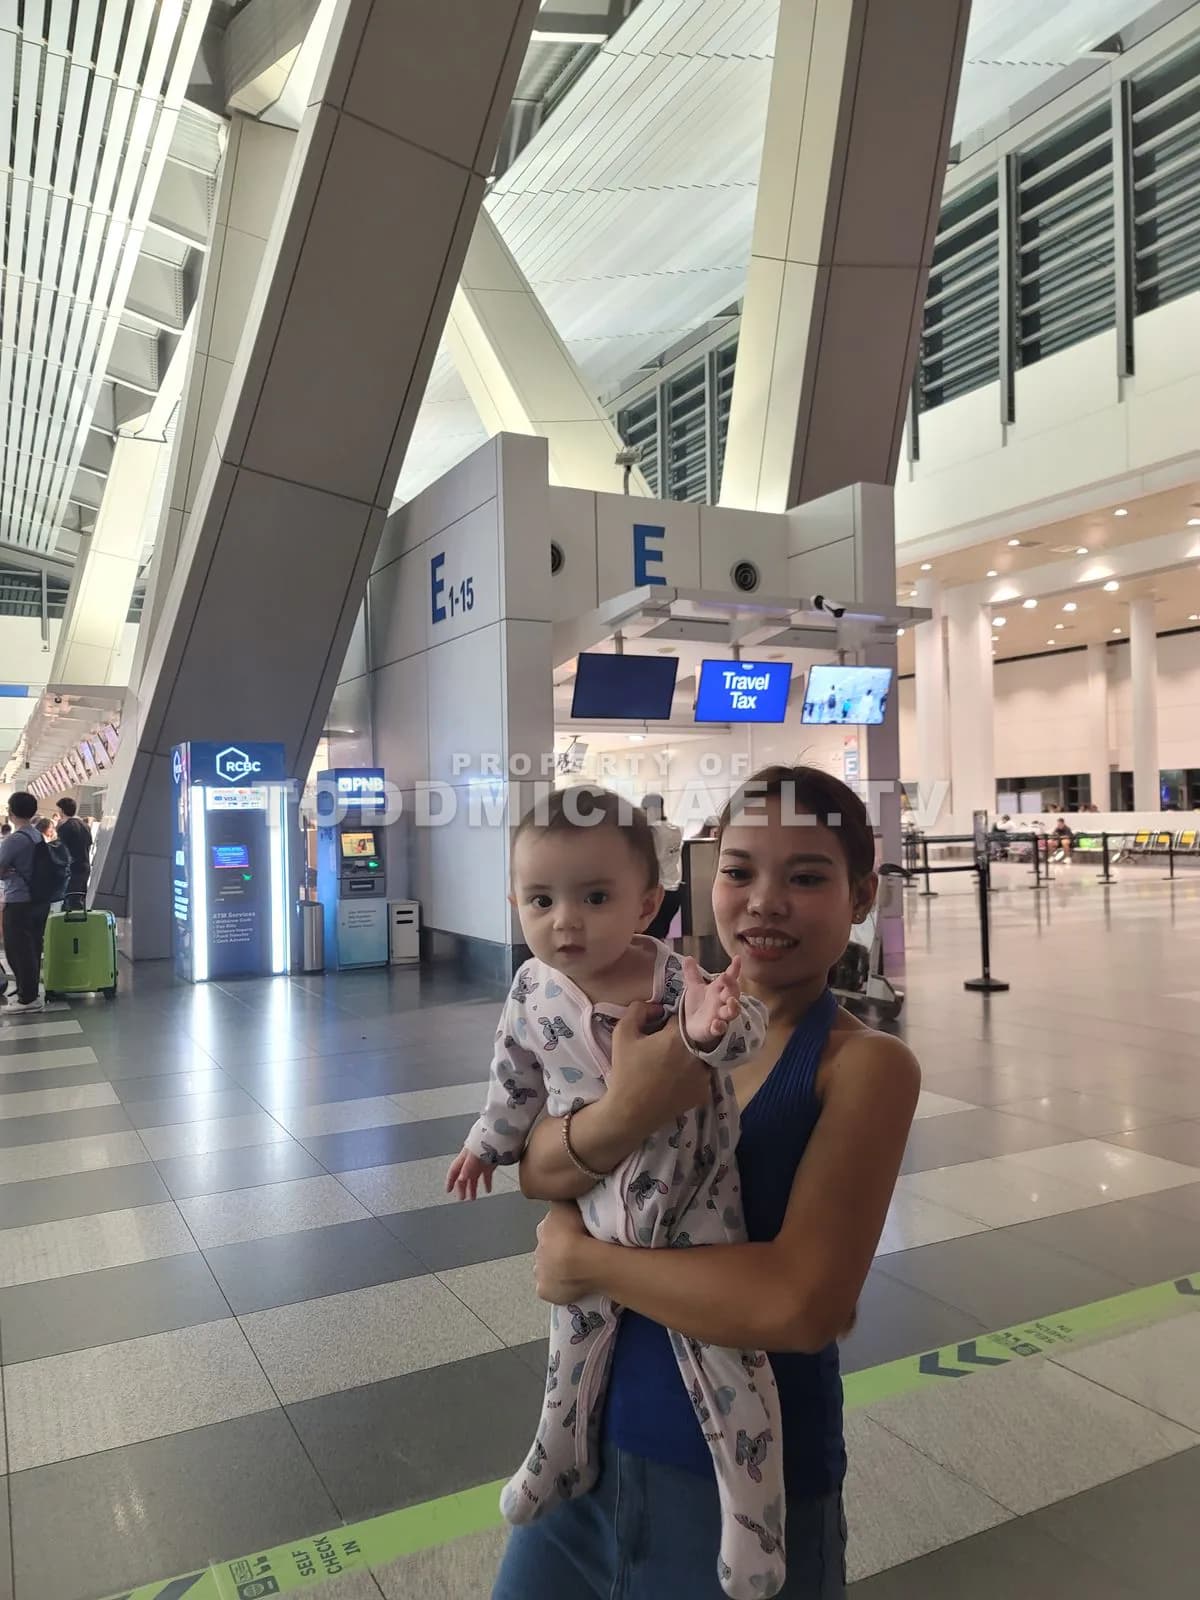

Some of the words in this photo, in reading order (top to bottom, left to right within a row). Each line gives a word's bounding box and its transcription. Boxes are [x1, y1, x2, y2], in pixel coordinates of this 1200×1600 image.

[633, 524, 667, 587] E
[431, 552, 446, 624] E
[449, 577, 474, 617] 1-15
[722, 671, 770, 691] Travel
[730, 691, 758, 710] Tax
[226, 761, 261, 772] RCBC
[352, 777, 384, 792] PNB
[313, 1536, 343, 1575] CHECK
[342, 1540, 361, 1556] IN
[292, 1551, 316, 1577] SELF
